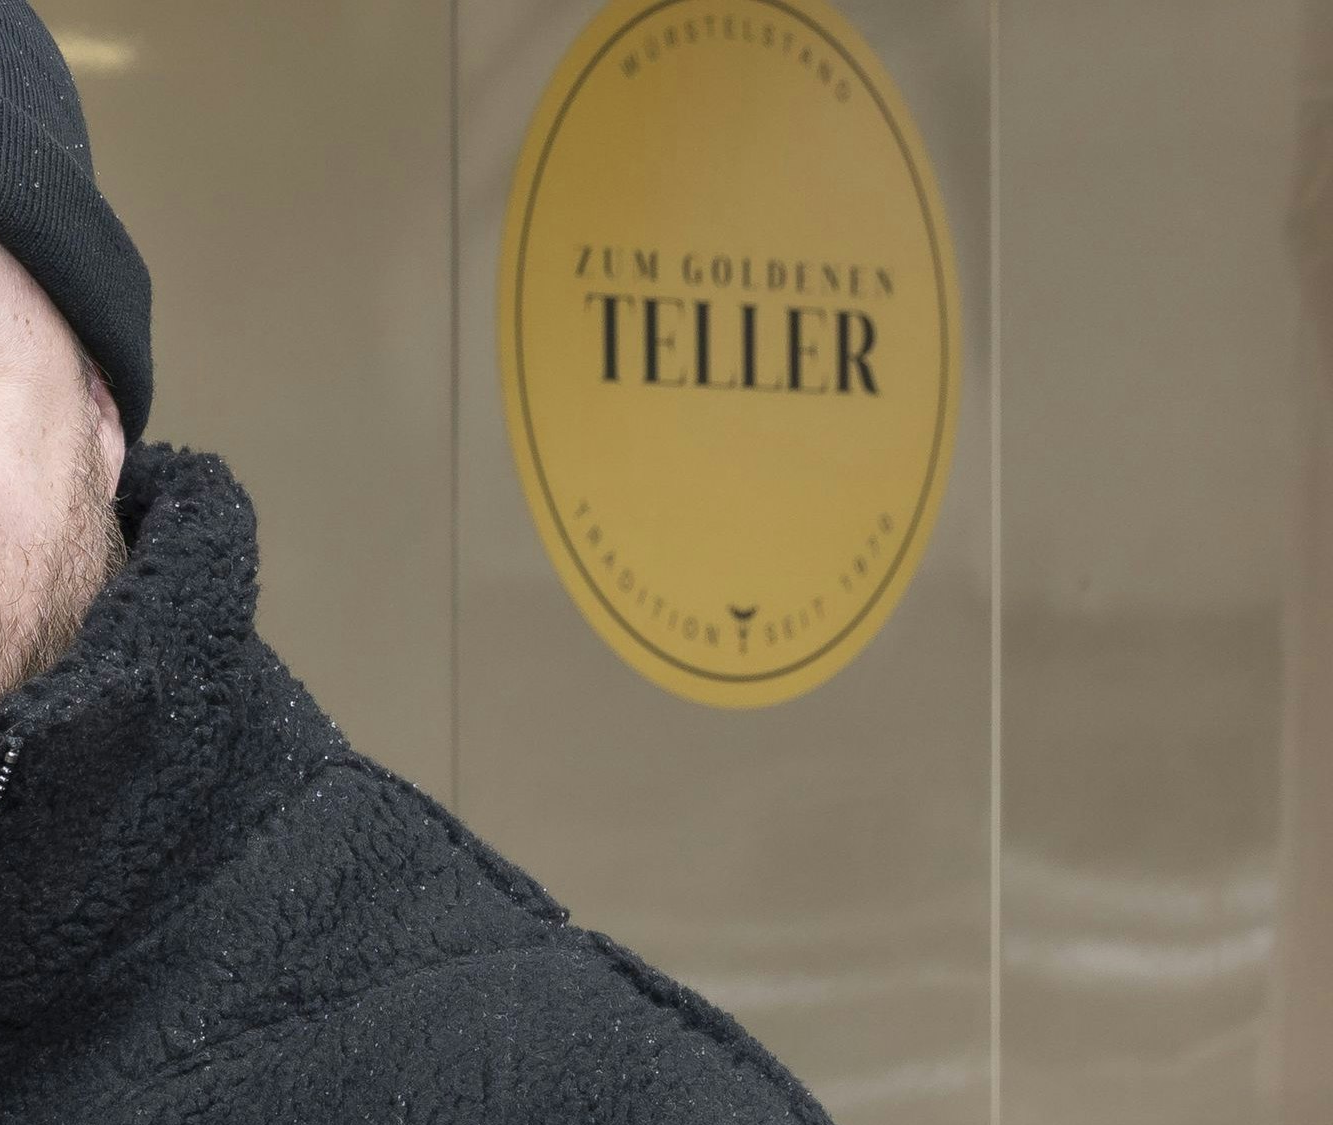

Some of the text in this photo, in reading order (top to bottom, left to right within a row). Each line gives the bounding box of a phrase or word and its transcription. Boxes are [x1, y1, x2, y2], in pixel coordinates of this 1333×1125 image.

[574, 245, 895, 298] ZUM GOLDENEN
[583, 291, 882, 397] TELLER
